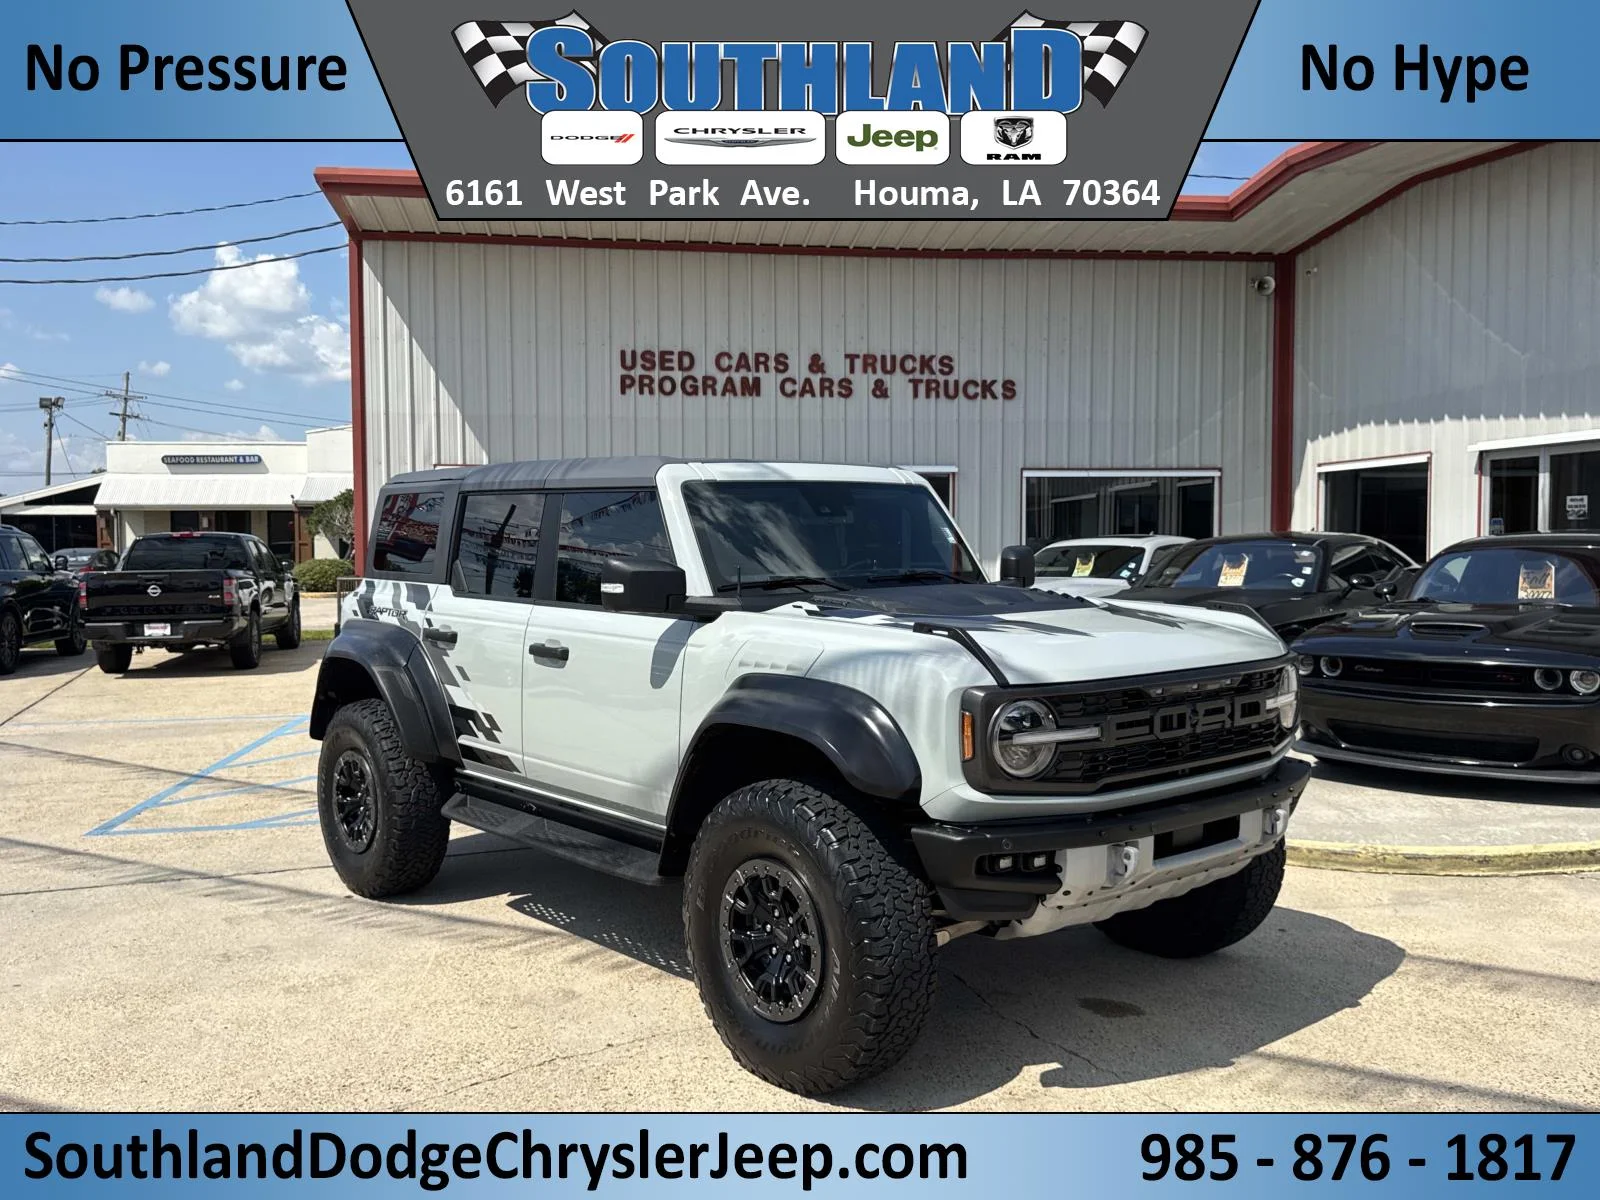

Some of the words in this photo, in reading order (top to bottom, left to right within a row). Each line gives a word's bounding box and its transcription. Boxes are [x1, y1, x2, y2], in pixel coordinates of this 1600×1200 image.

[619, 350, 695, 372] USED
[714, 351, 790, 374] CARS
[808, 353, 826, 375] &
[844, 353, 955, 376] TRUCKS
[619, 374, 762, 398] PROGRAM
[779, 376, 854, 399] CARS
[871, 377, 890, 399] &
[908, 378, 1018, 400] TRUCKS
[163, 456, 195, 464] SEAFOOD
[196, 456, 237, 464] RESTAURANT
[246, 456, 259, 464] BAR
[368, 605, 408, 620] RAPTOR
[1102, 694, 1268, 744] FORD
